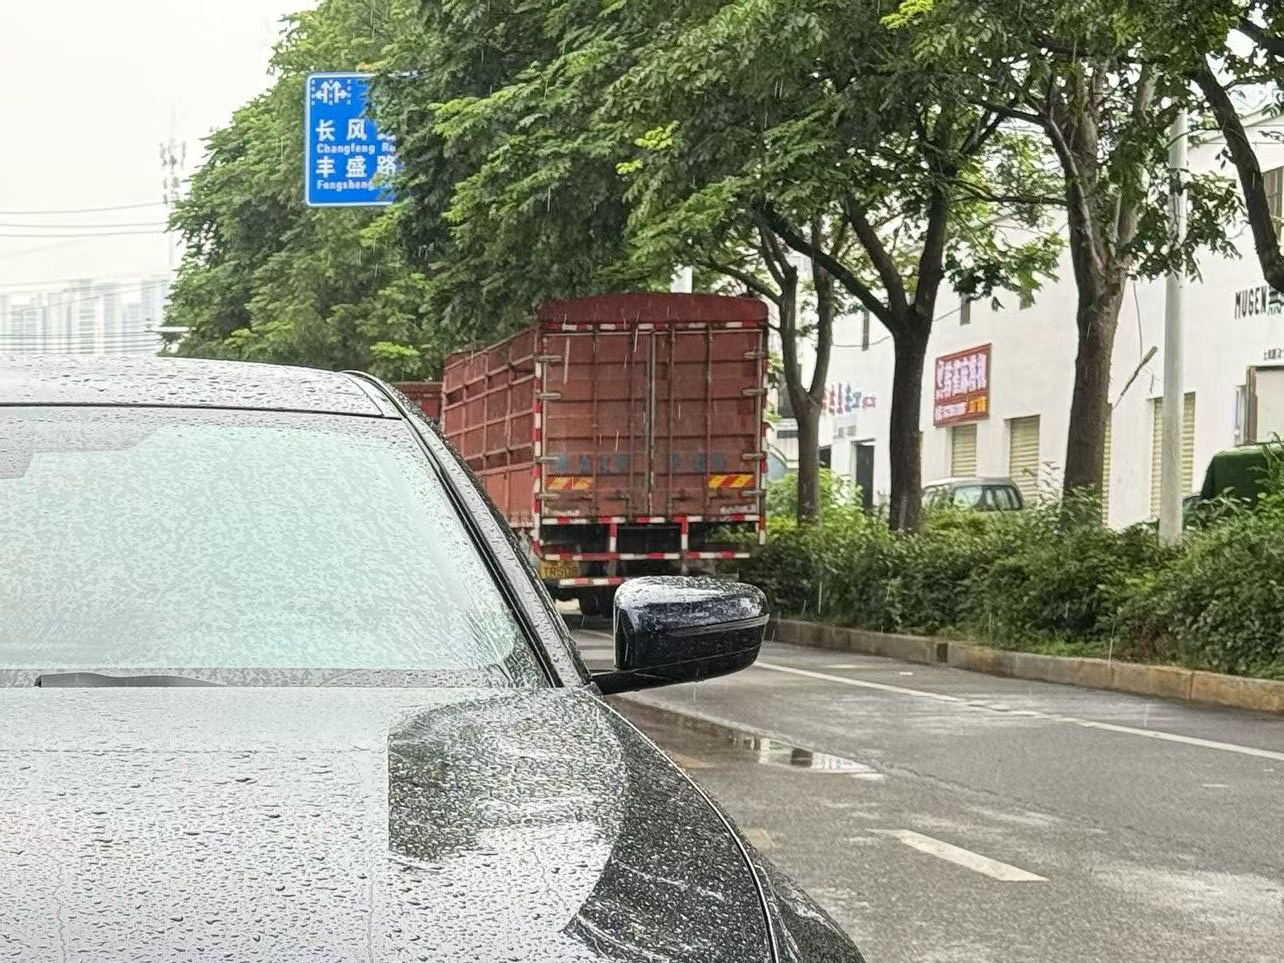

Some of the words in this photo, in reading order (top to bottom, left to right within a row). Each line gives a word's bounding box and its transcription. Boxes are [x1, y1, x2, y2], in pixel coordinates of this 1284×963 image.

[316, 118, 397, 142] 长风
[316, 143, 376, 156] Changfeng
[316, 155, 397, 178] 丰盛路
[1234, 285, 1267, 319] MUGEN
